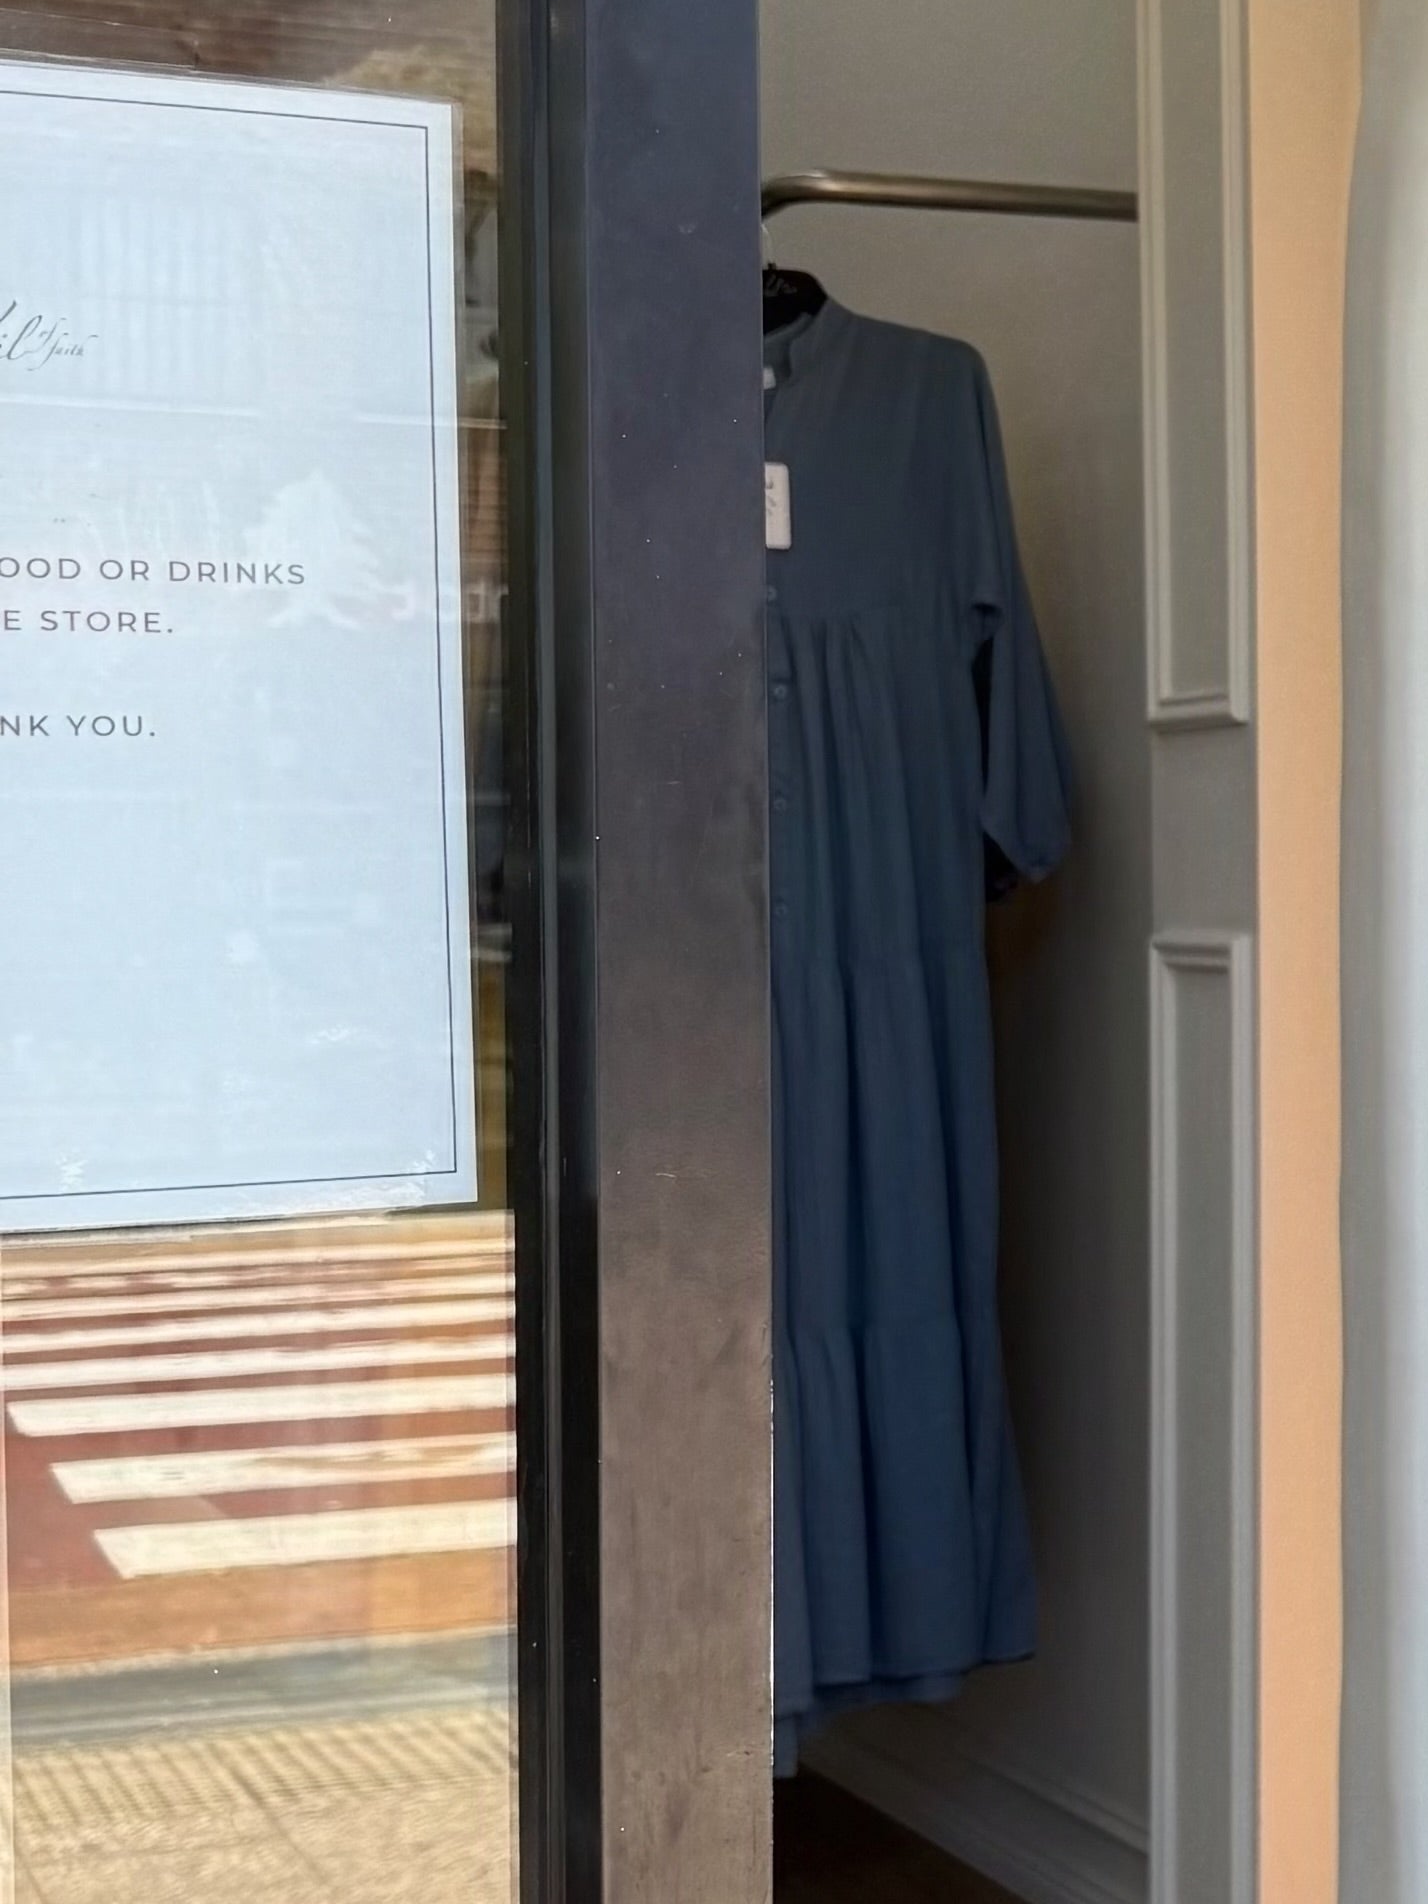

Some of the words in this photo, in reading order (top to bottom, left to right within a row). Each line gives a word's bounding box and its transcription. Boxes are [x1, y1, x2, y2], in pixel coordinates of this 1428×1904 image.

[100, 560, 150, 581] OR
[169, 561, 305, 584] DRINKS
[40, 610, 173, 633] STORE.
[66, 715, 155, 737] YOU.
